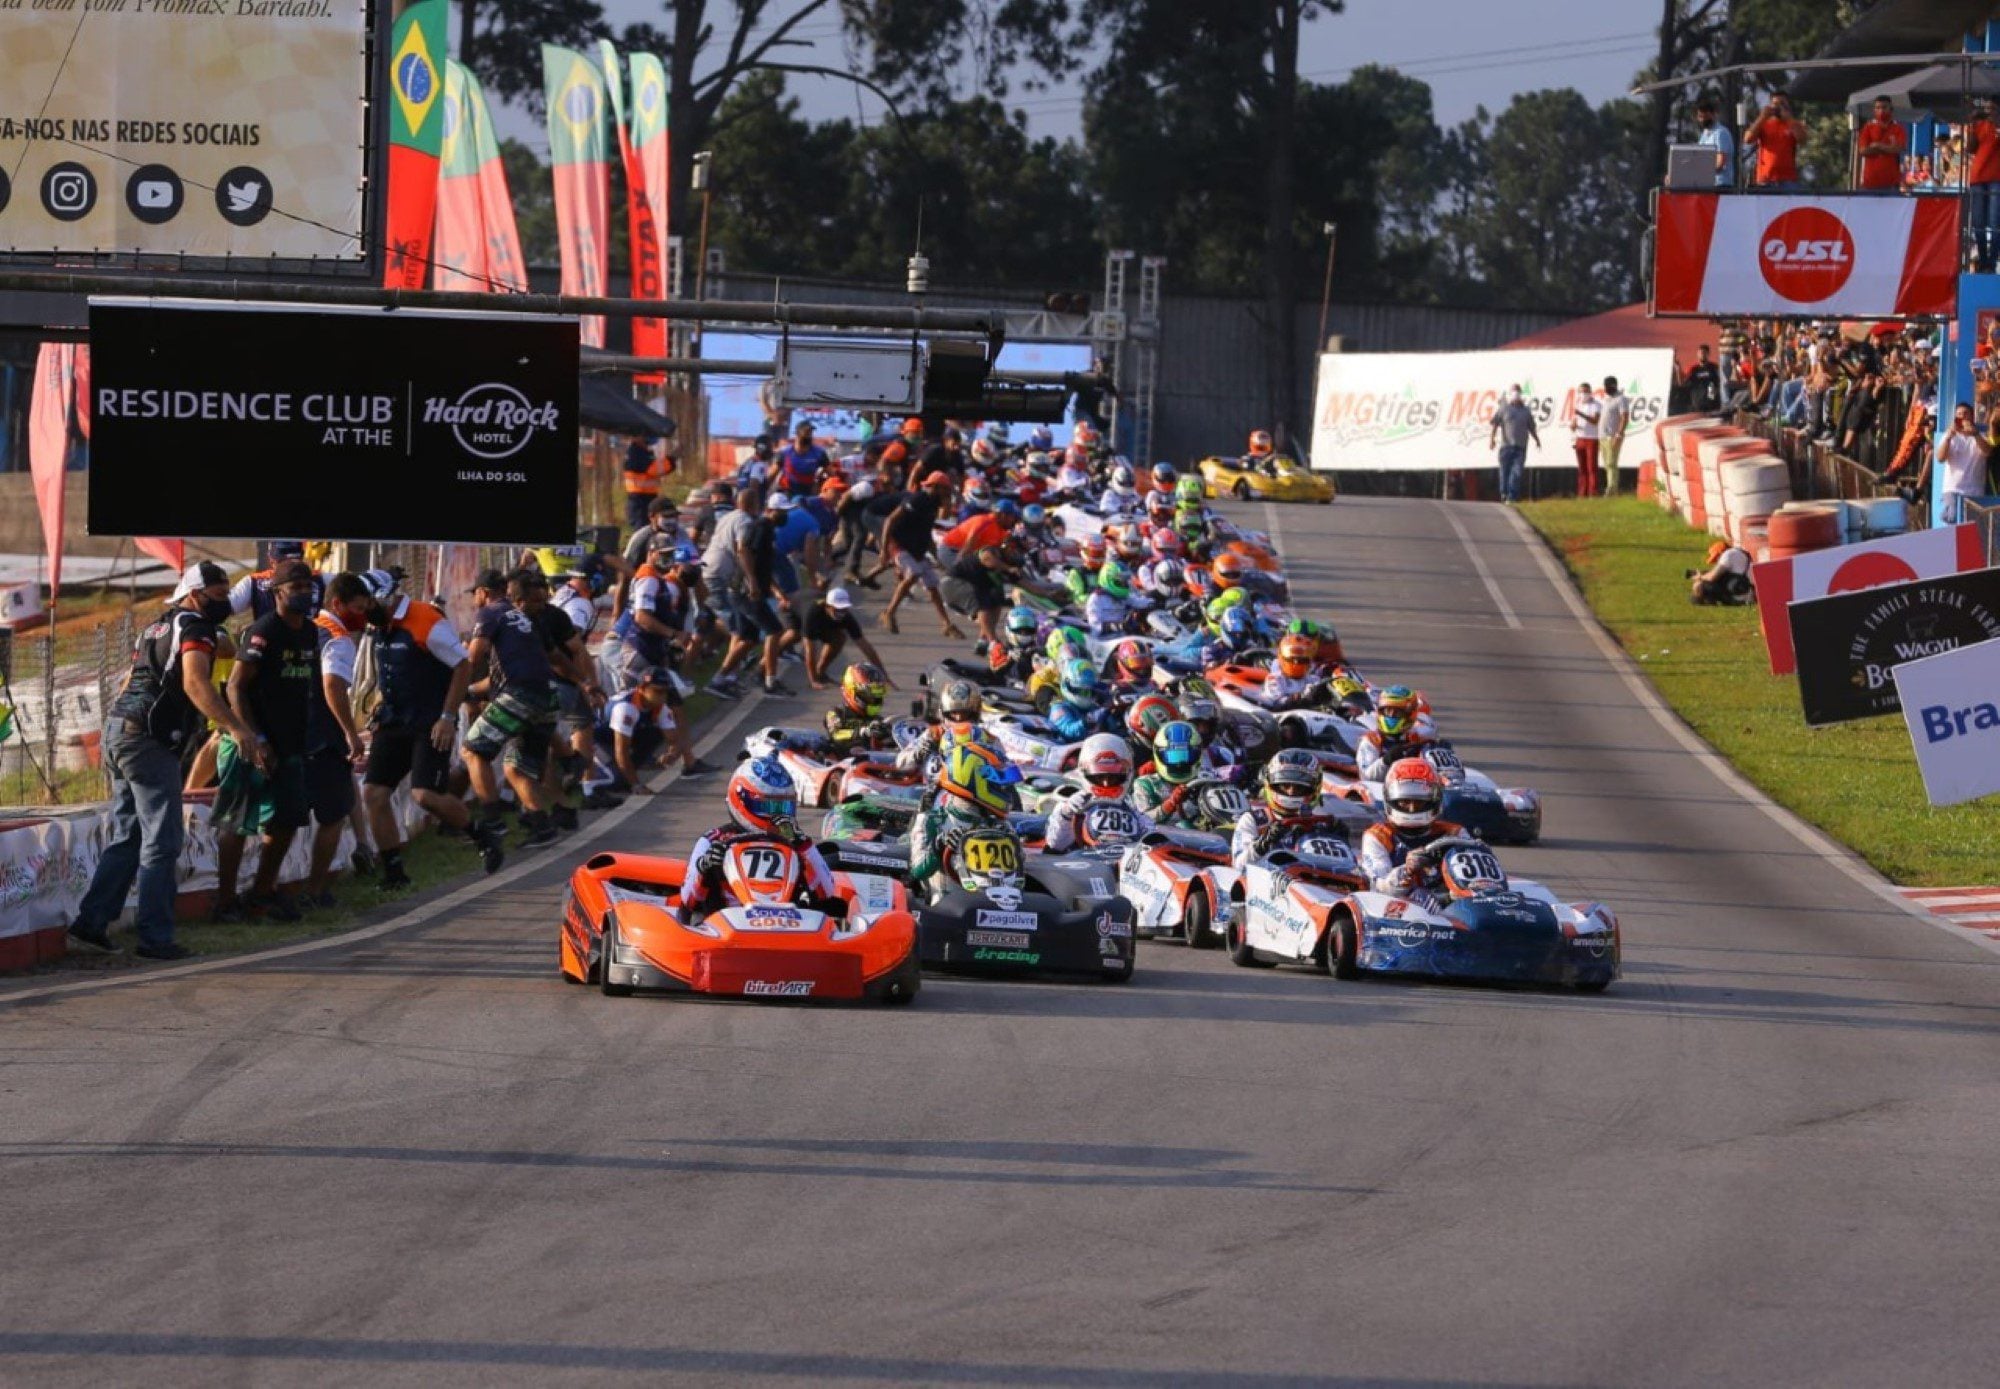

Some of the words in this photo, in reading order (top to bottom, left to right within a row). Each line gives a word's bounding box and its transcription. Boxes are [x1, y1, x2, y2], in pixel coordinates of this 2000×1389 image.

[232, 0, 332, 17] Bardahl.
[0, 117, 66, 141] A-NOS
[72, 118, 110, 142] NAS
[116, 120, 177, 143] REDES
[182, 123, 261, 146] SOCIAIS
[1786, 240, 1850, 262] JSL
[98, 388, 292, 421] RESIDENCE
[301, 394, 393, 424] CLUB
[423, 397, 494, 424] Hard
[494, 399, 560, 431] Rock
[321, 427, 349, 444] AT
[351, 428, 393, 446] THE
[472, 432, 513, 443] HOTEL
[456, 470, 484, 481] ILHA
[485, 471, 504, 482] DO
[505, 472, 528, 482] SOL
[1096, 808, 1136, 834] 293
[970, 843, 1015, 871] 120
[1310, 838, 1349, 858] 85
[744, 849, 784, 880] 72
[1457, 852, 1501, 880] 318
